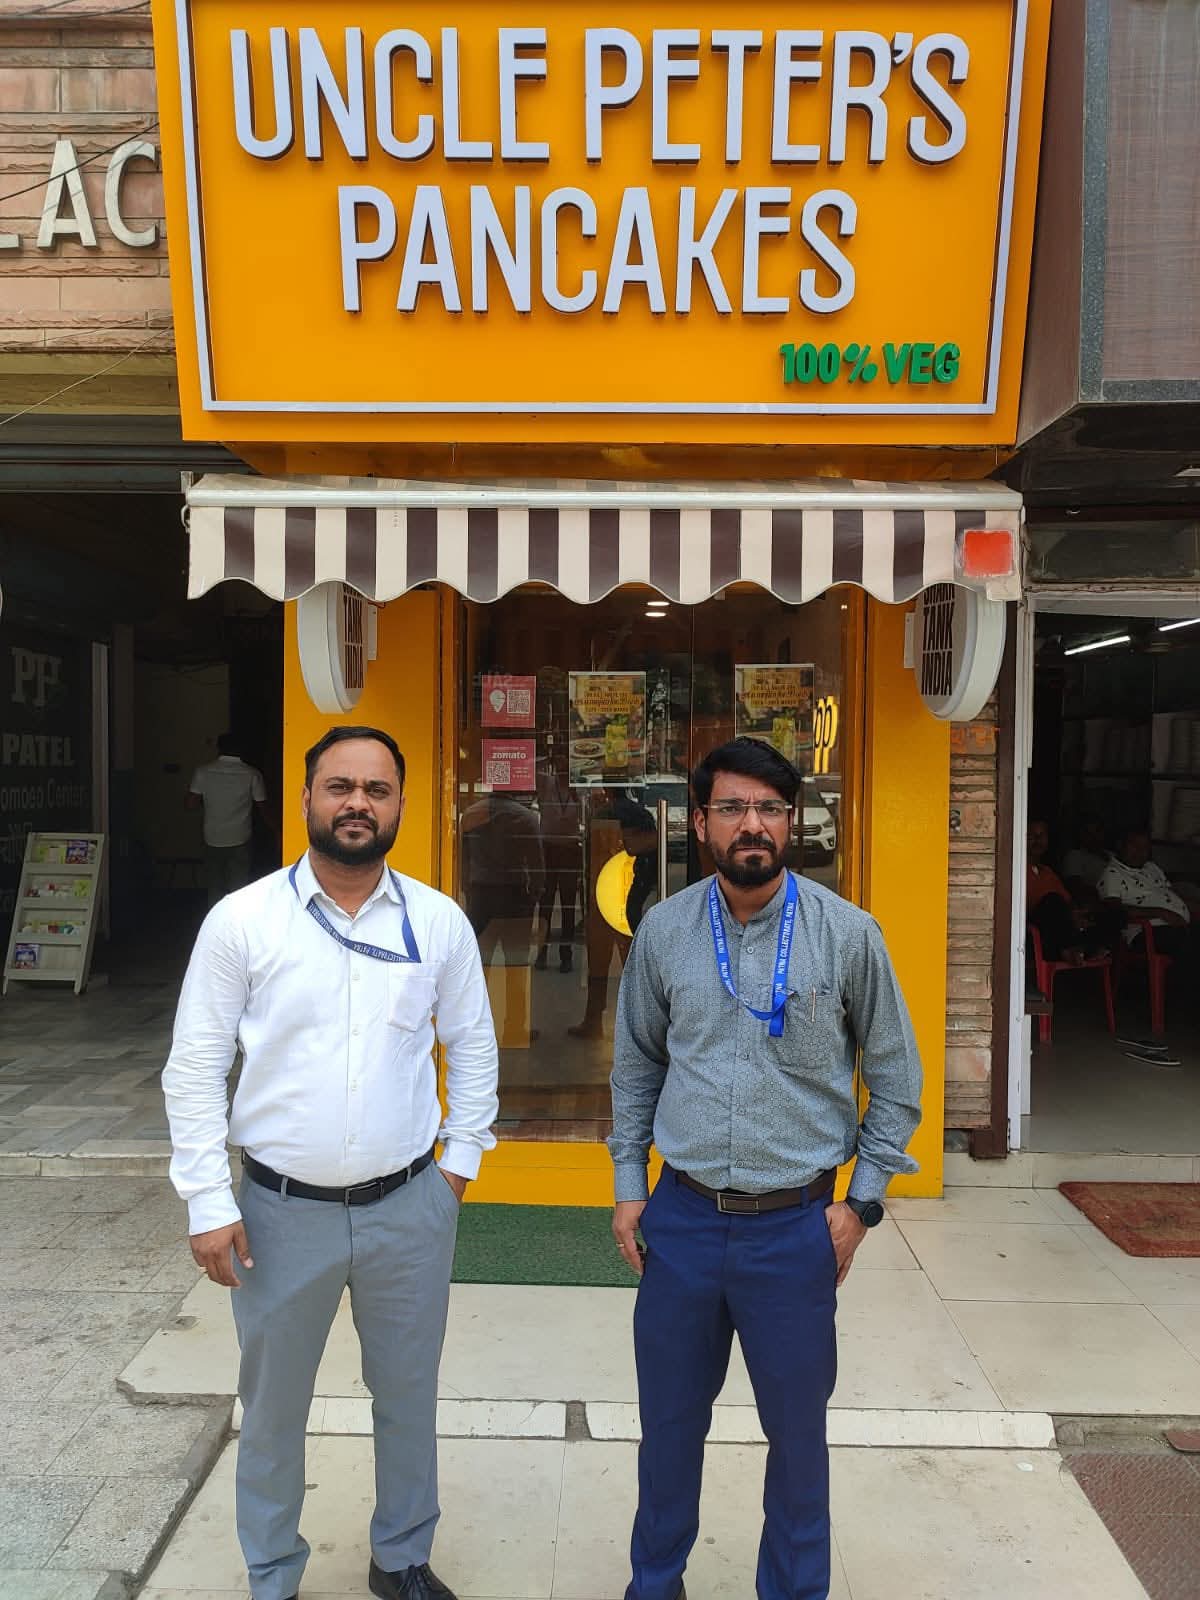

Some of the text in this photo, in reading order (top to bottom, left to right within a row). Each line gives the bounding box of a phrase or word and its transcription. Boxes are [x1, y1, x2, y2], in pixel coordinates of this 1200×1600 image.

[230, 27, 970, 164] UNCLE PETER'S
[0, 139, 157, 250] AC
[338, 185, 858, 314] PANCAKES
[779, 342, 961, 385] 100% VEG
[923, 602, 955, 651] TANK
[920, 651, 953, 696] INDIA
[2, 732, 76, 767] PATEL
[492, 751, 527, 760] zomato
